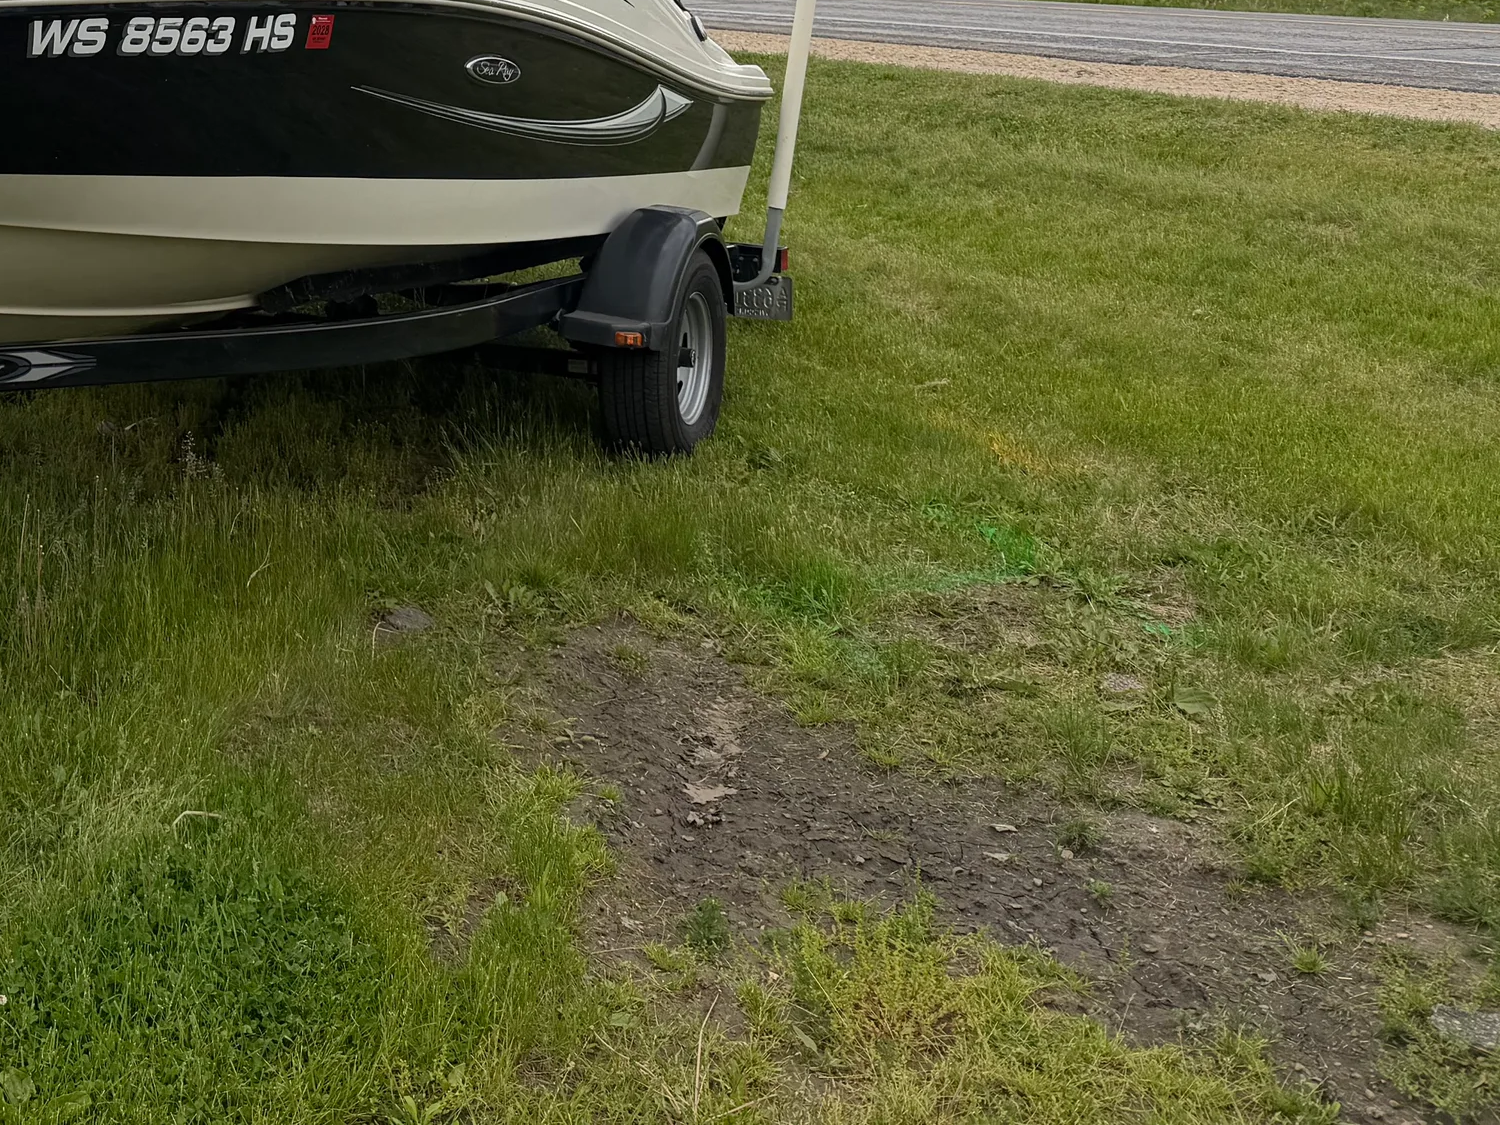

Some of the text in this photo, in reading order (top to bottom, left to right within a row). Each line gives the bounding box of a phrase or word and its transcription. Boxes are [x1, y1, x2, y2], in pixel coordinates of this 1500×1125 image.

[29, 13, 296, 57] WS 8563 HS
[312, 25, 330, 36] 2028
[476, 61, 515, 81] Sea Ray
